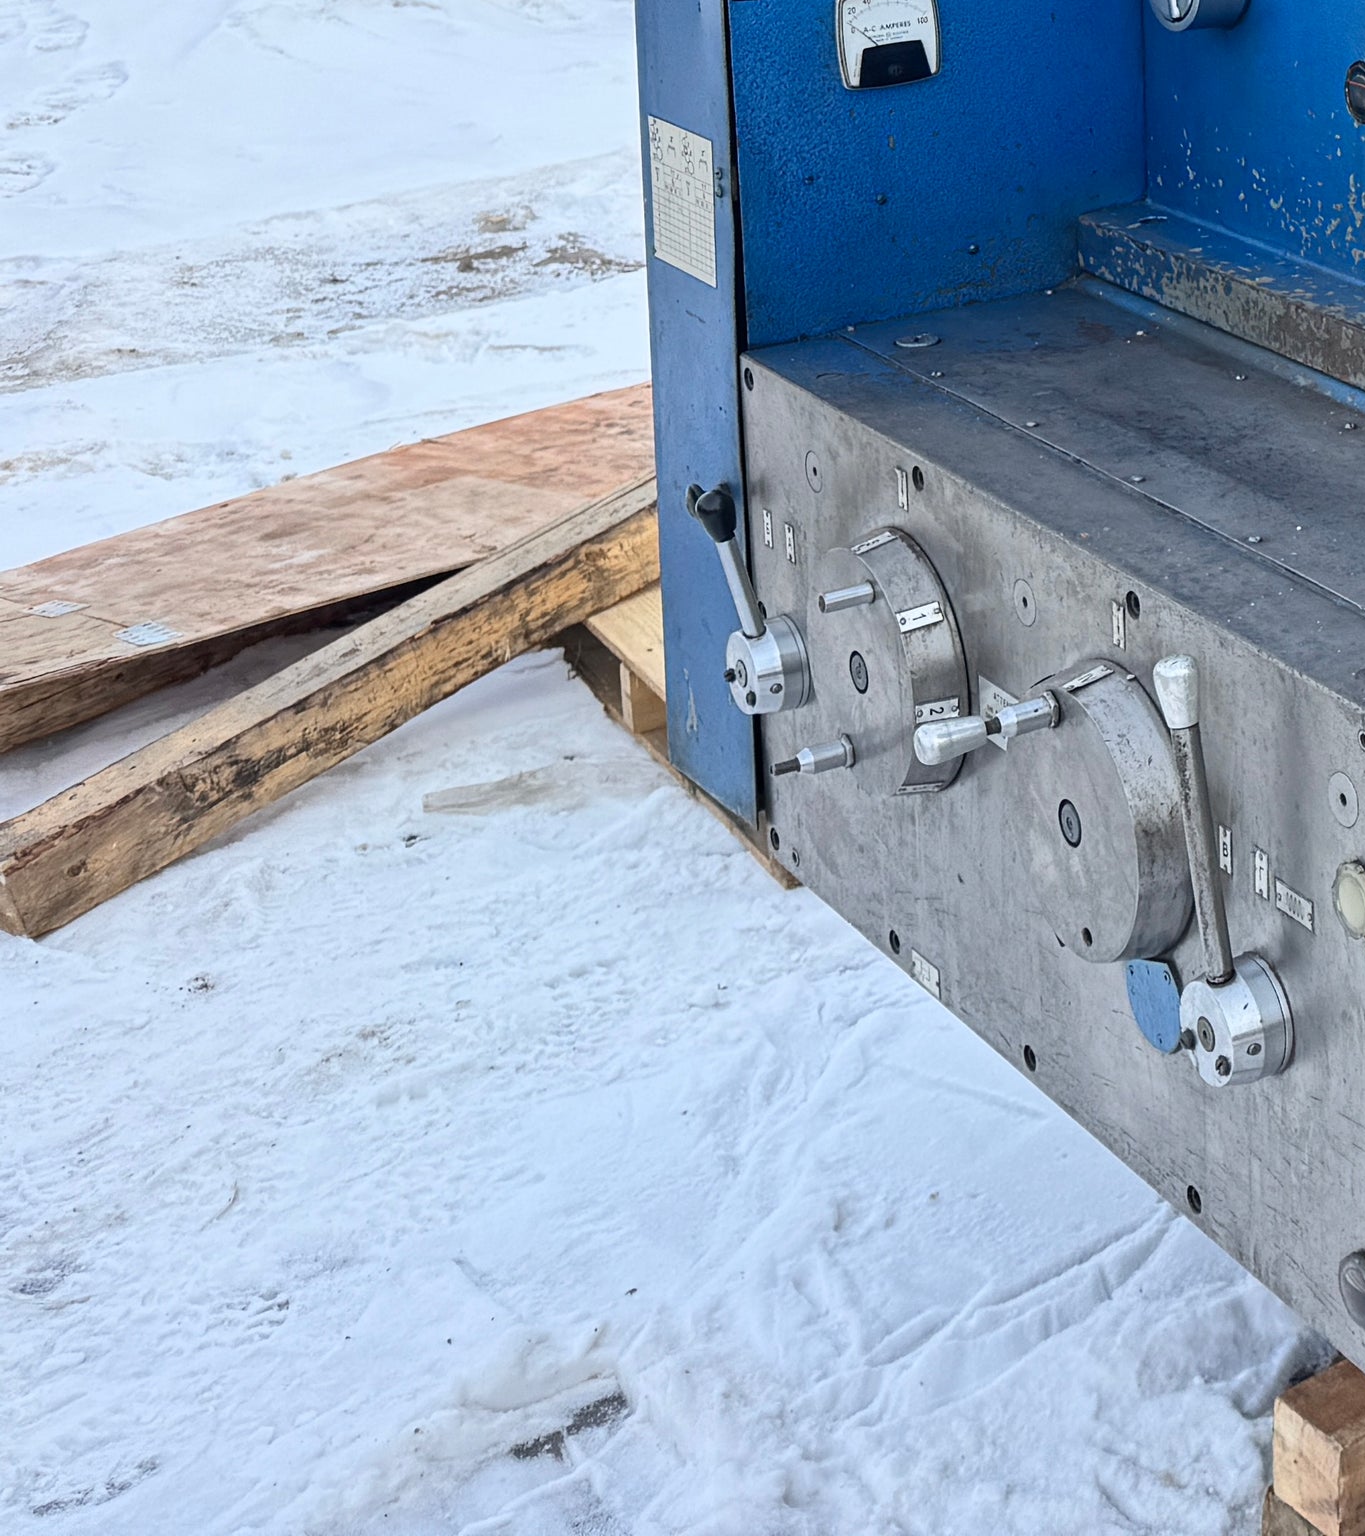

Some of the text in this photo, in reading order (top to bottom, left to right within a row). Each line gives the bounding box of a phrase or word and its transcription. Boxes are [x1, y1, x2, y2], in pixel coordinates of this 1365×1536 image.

[847, 6, 857, 16] 20
[879, 20, 912, 31] AMPERES
[917, 16, 929, 25] 100
[929, 706, 945, 716] 2
